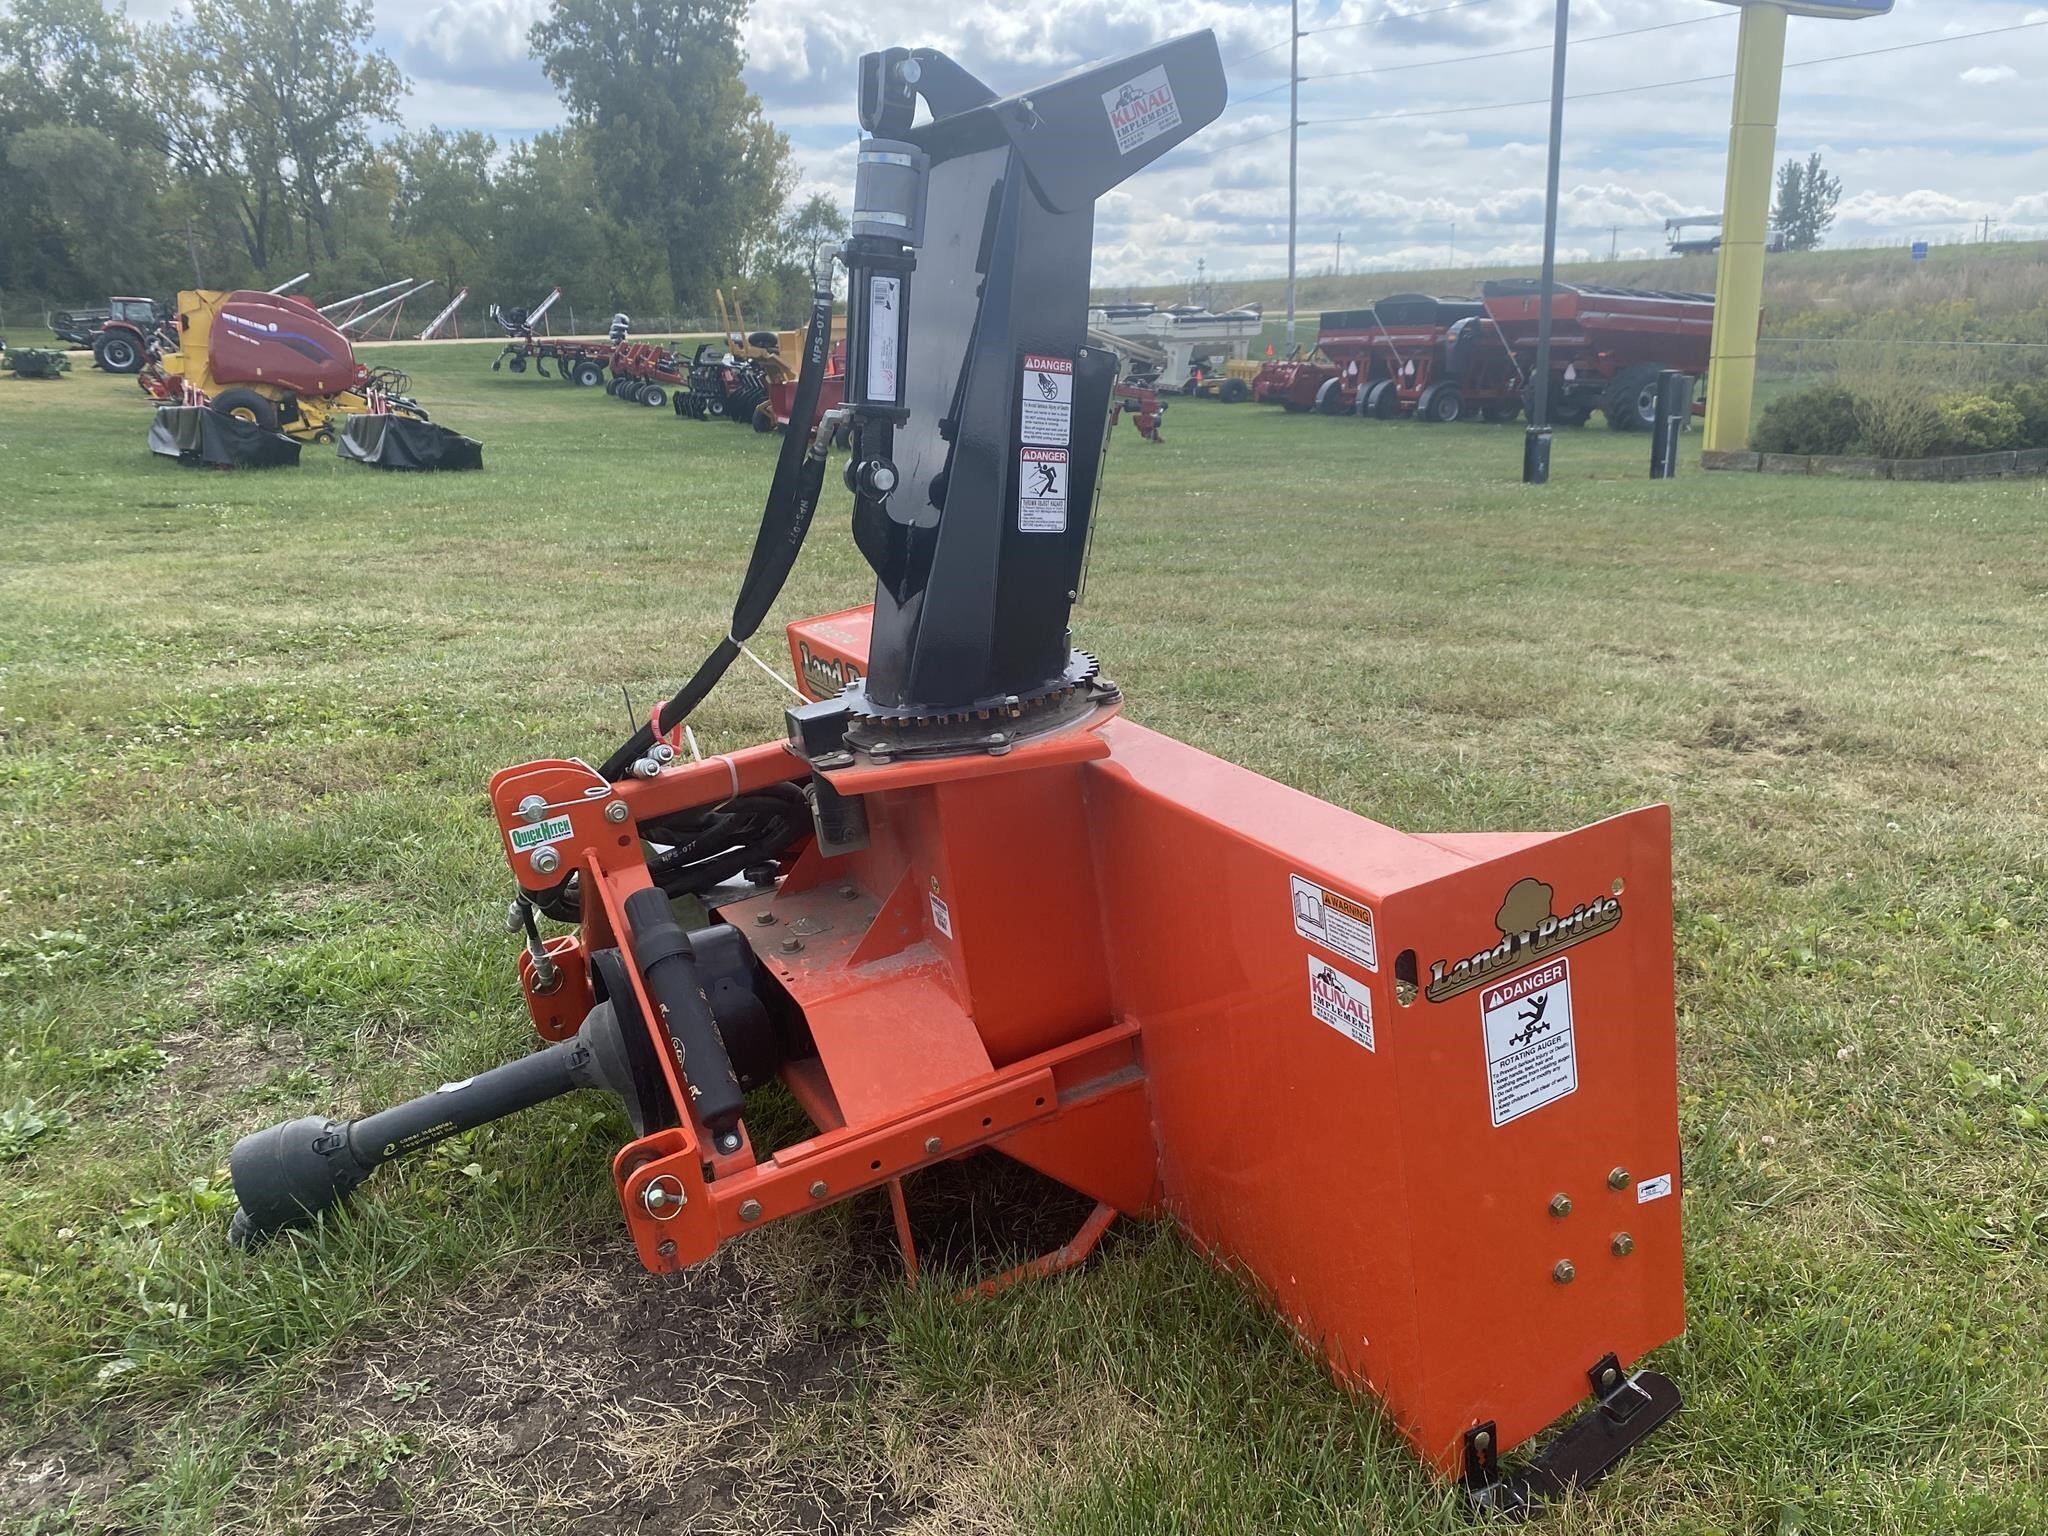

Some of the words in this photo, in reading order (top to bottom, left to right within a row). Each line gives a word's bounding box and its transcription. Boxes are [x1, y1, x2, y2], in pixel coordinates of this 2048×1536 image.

[1116, 102, 1175, 138] IMPLEMENT
[1034, 358, 1072, 372] DANGER
[1030, 450, 1066, 462] DANGER
[1332, 897, 1369, 923] WARNING
[1429, 933, 1519, 994] Land
[1533, 896, 1622, 951] Pride
[1503, 965, 1562, 1001] DANGER
[1313, 993, 1371, 1034] IMPLEMENT
[1500, 1045, 1536, 1069] ROTATING
[1537, 1035, 1562, 1054] AUGER
